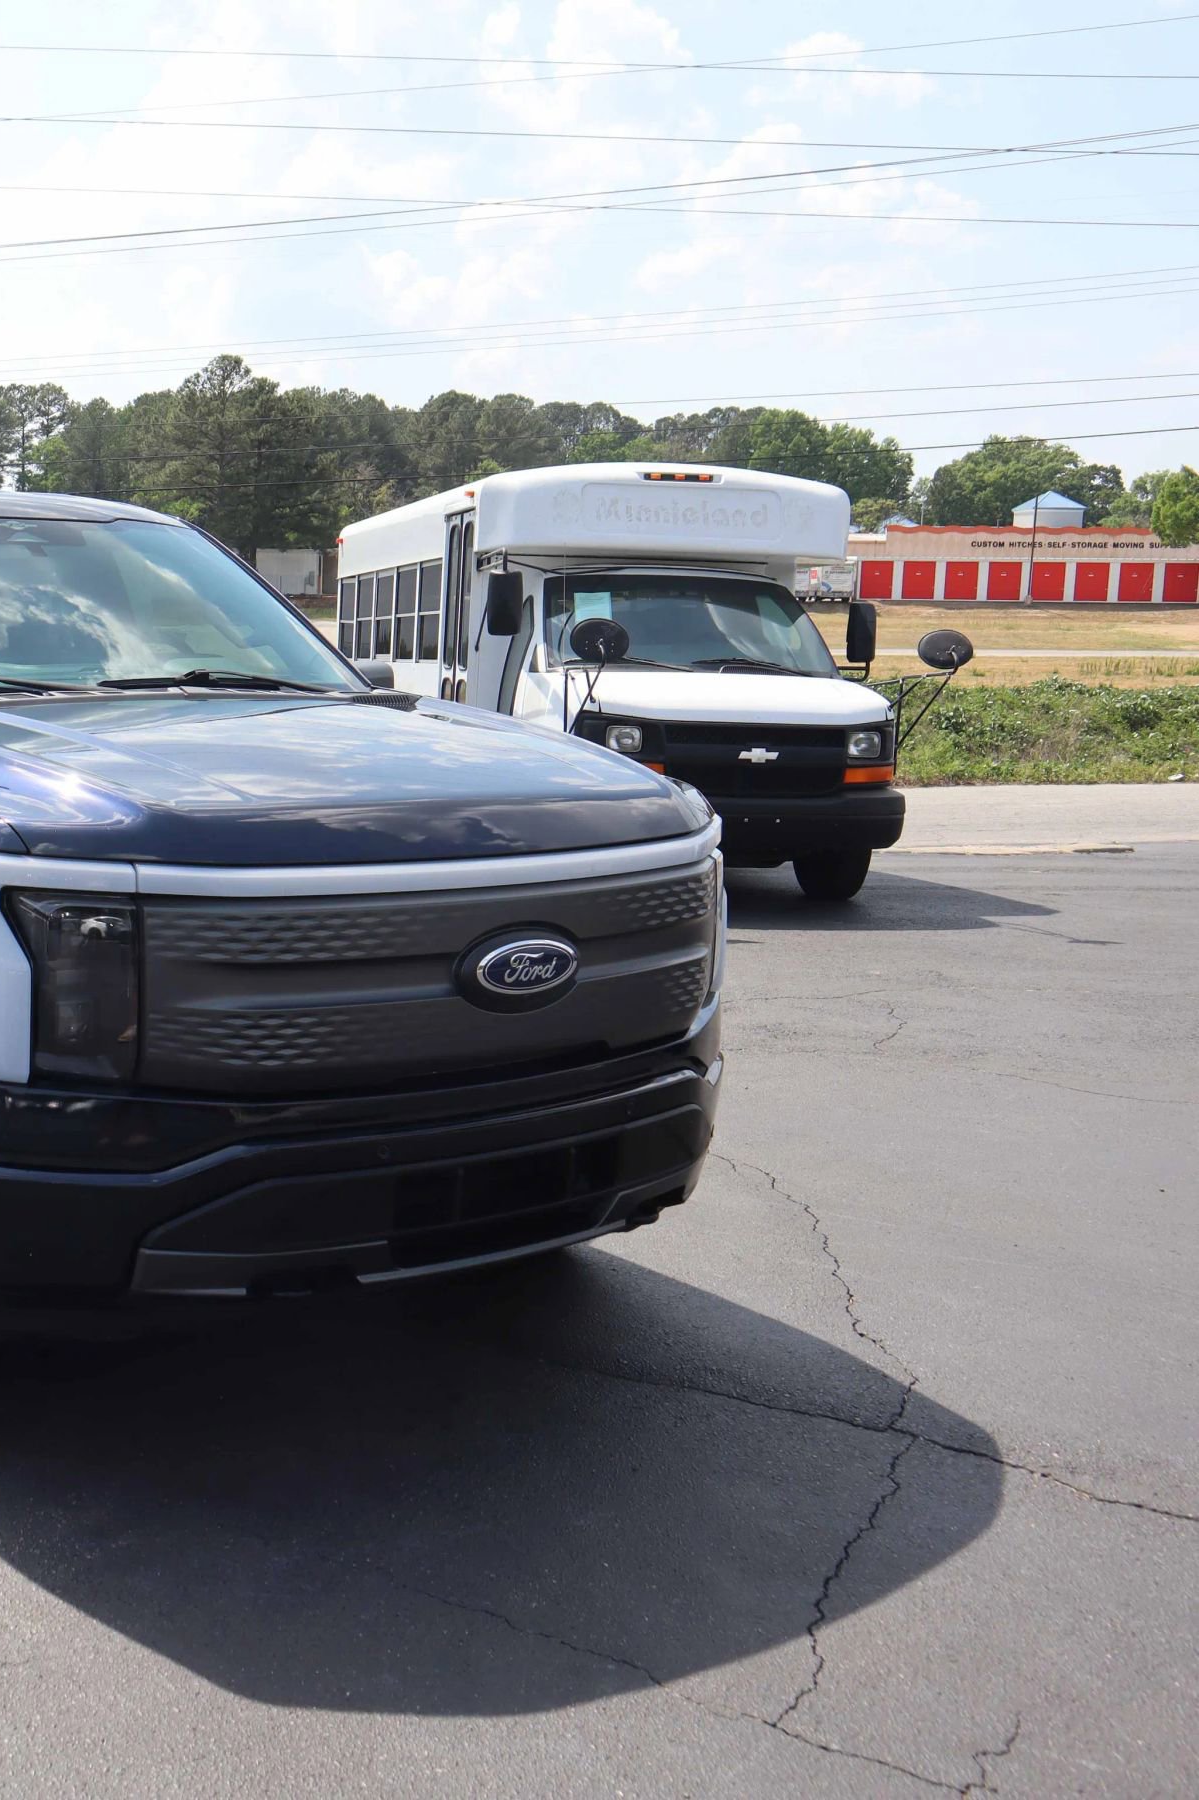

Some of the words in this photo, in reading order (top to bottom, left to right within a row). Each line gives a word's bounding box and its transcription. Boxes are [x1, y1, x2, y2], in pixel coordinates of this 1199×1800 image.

[1009, 541, 1043, 549] HITCHES
[1113, 541, 1144, 549] MOVING
[504, 951, 558, 983] Ford
